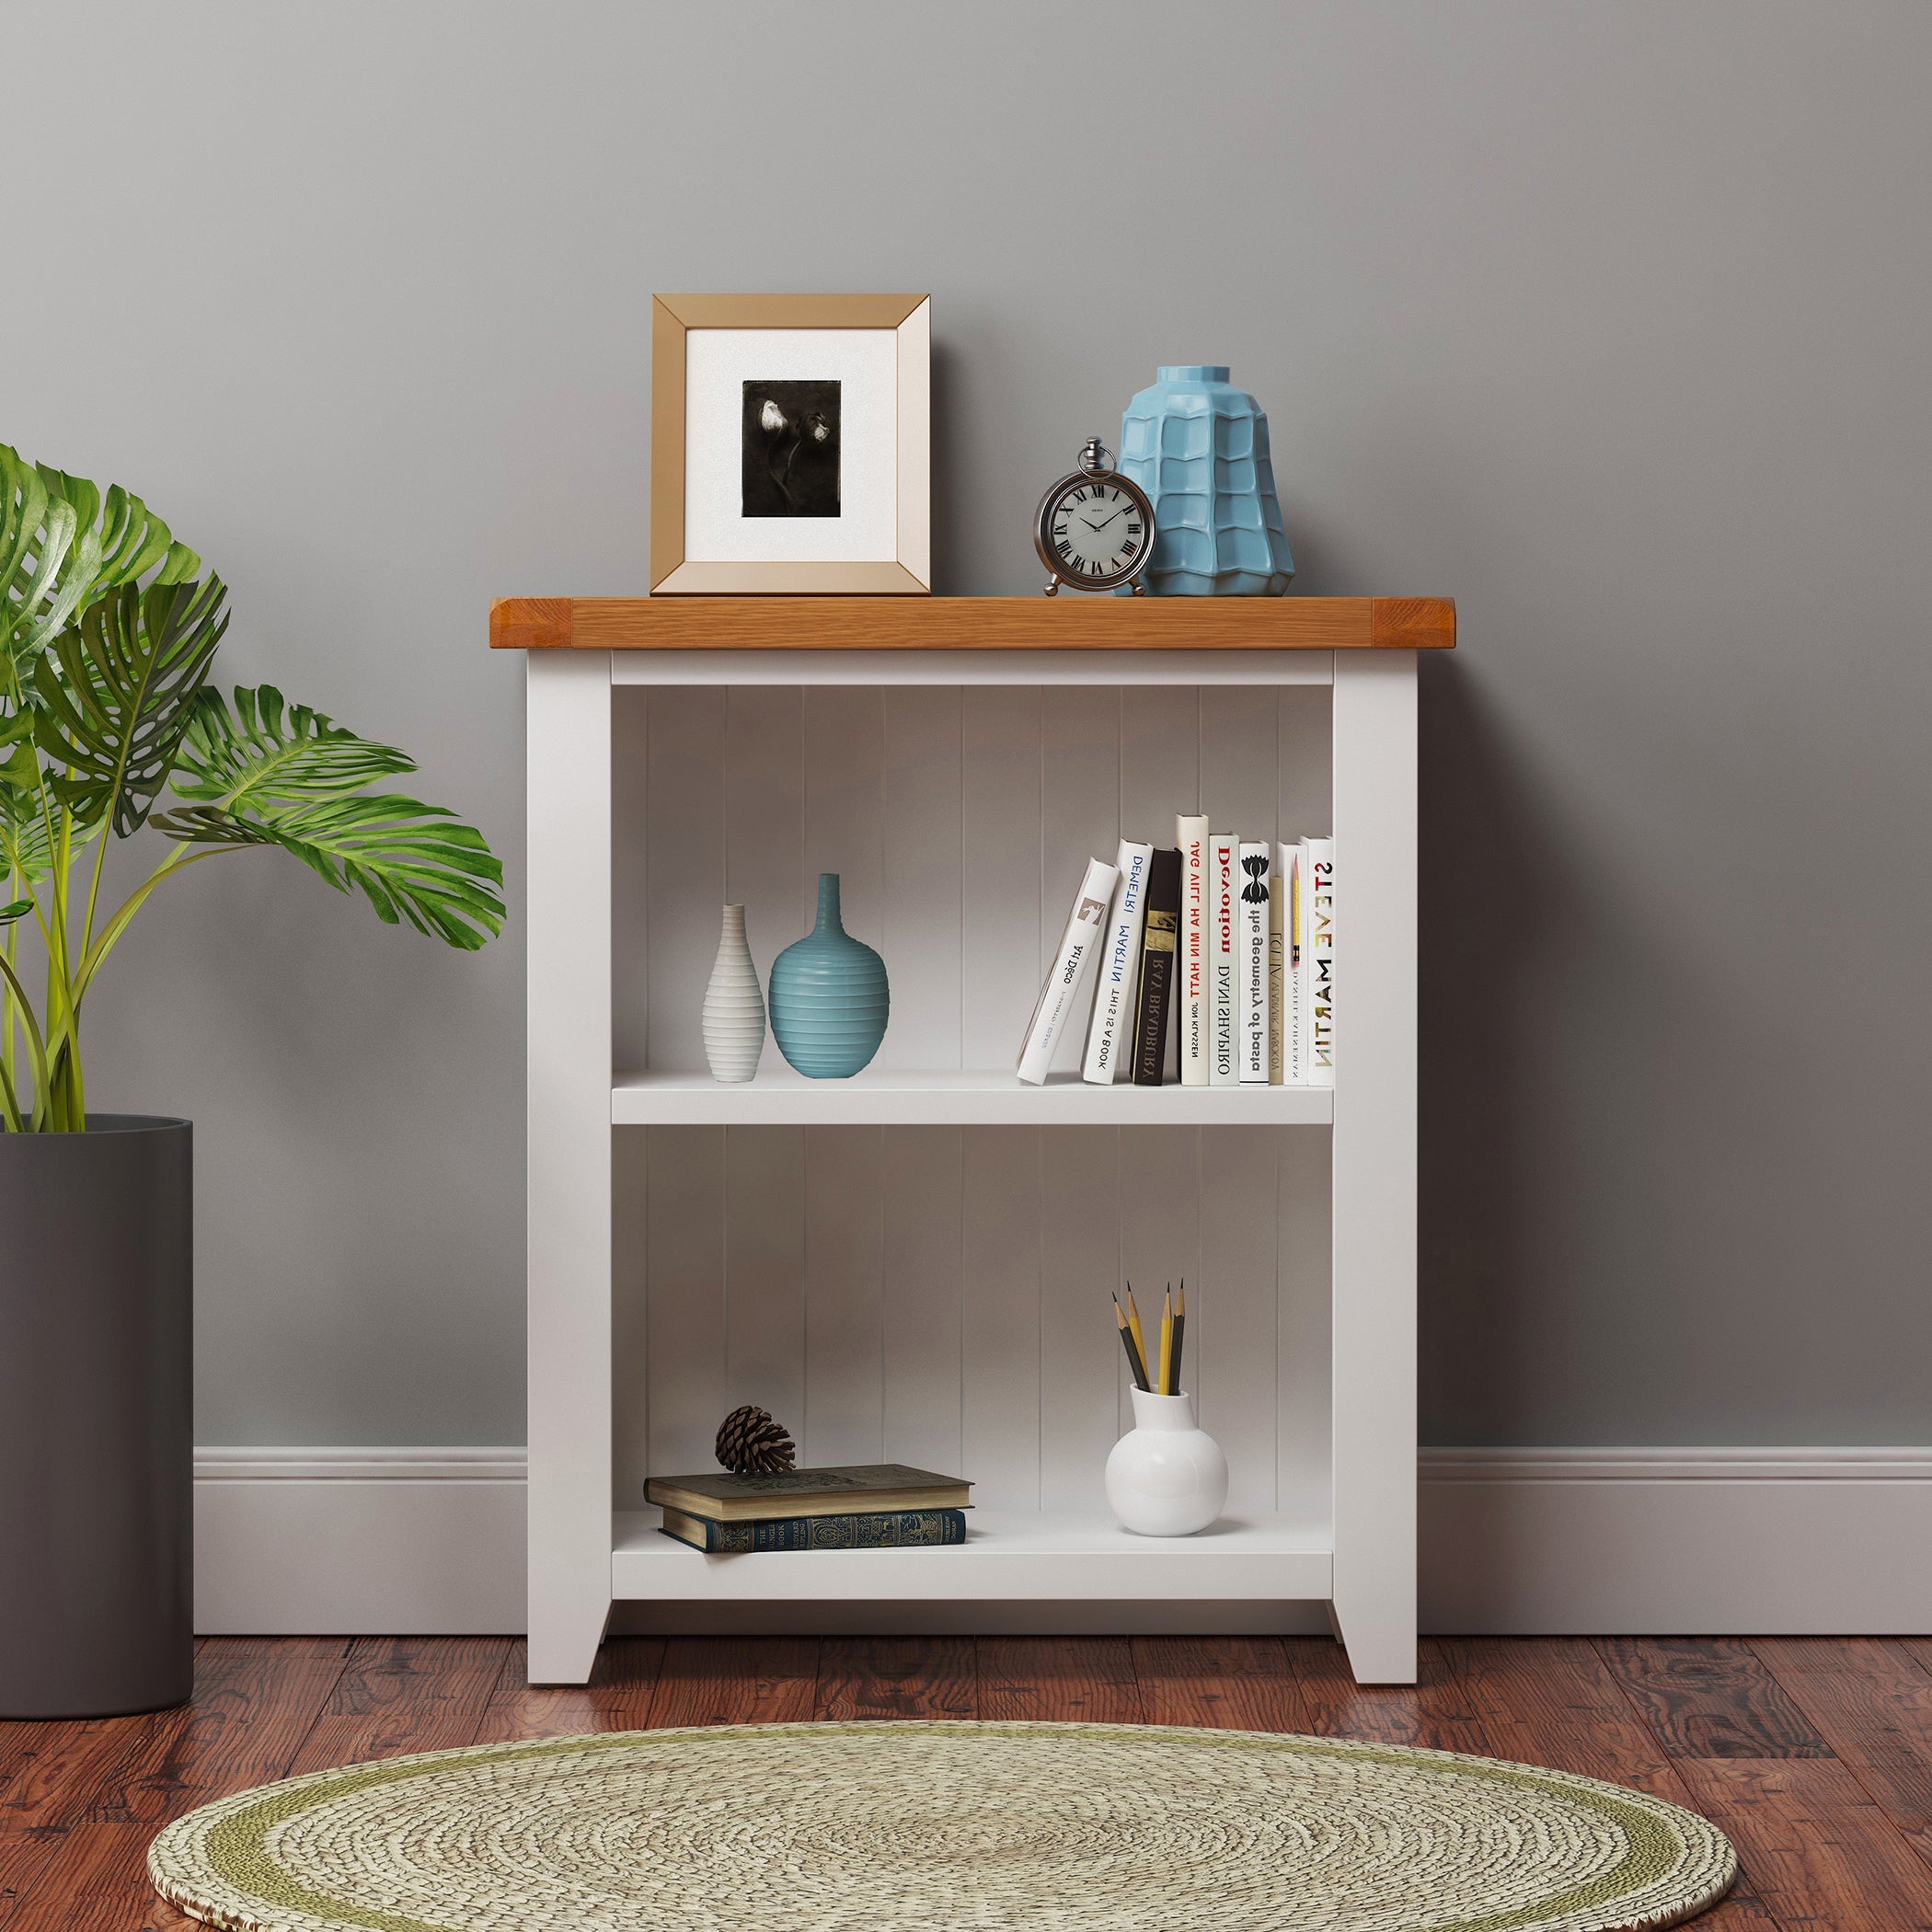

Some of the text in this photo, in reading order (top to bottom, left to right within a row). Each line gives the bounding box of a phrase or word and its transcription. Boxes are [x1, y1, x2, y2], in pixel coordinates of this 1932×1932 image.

[1091, 485, 1104, 499] XII
[1111, 489, 1120, 501] I
[1059, 503, 1075, 518] X
[1128, 523, 1141, 534] III
